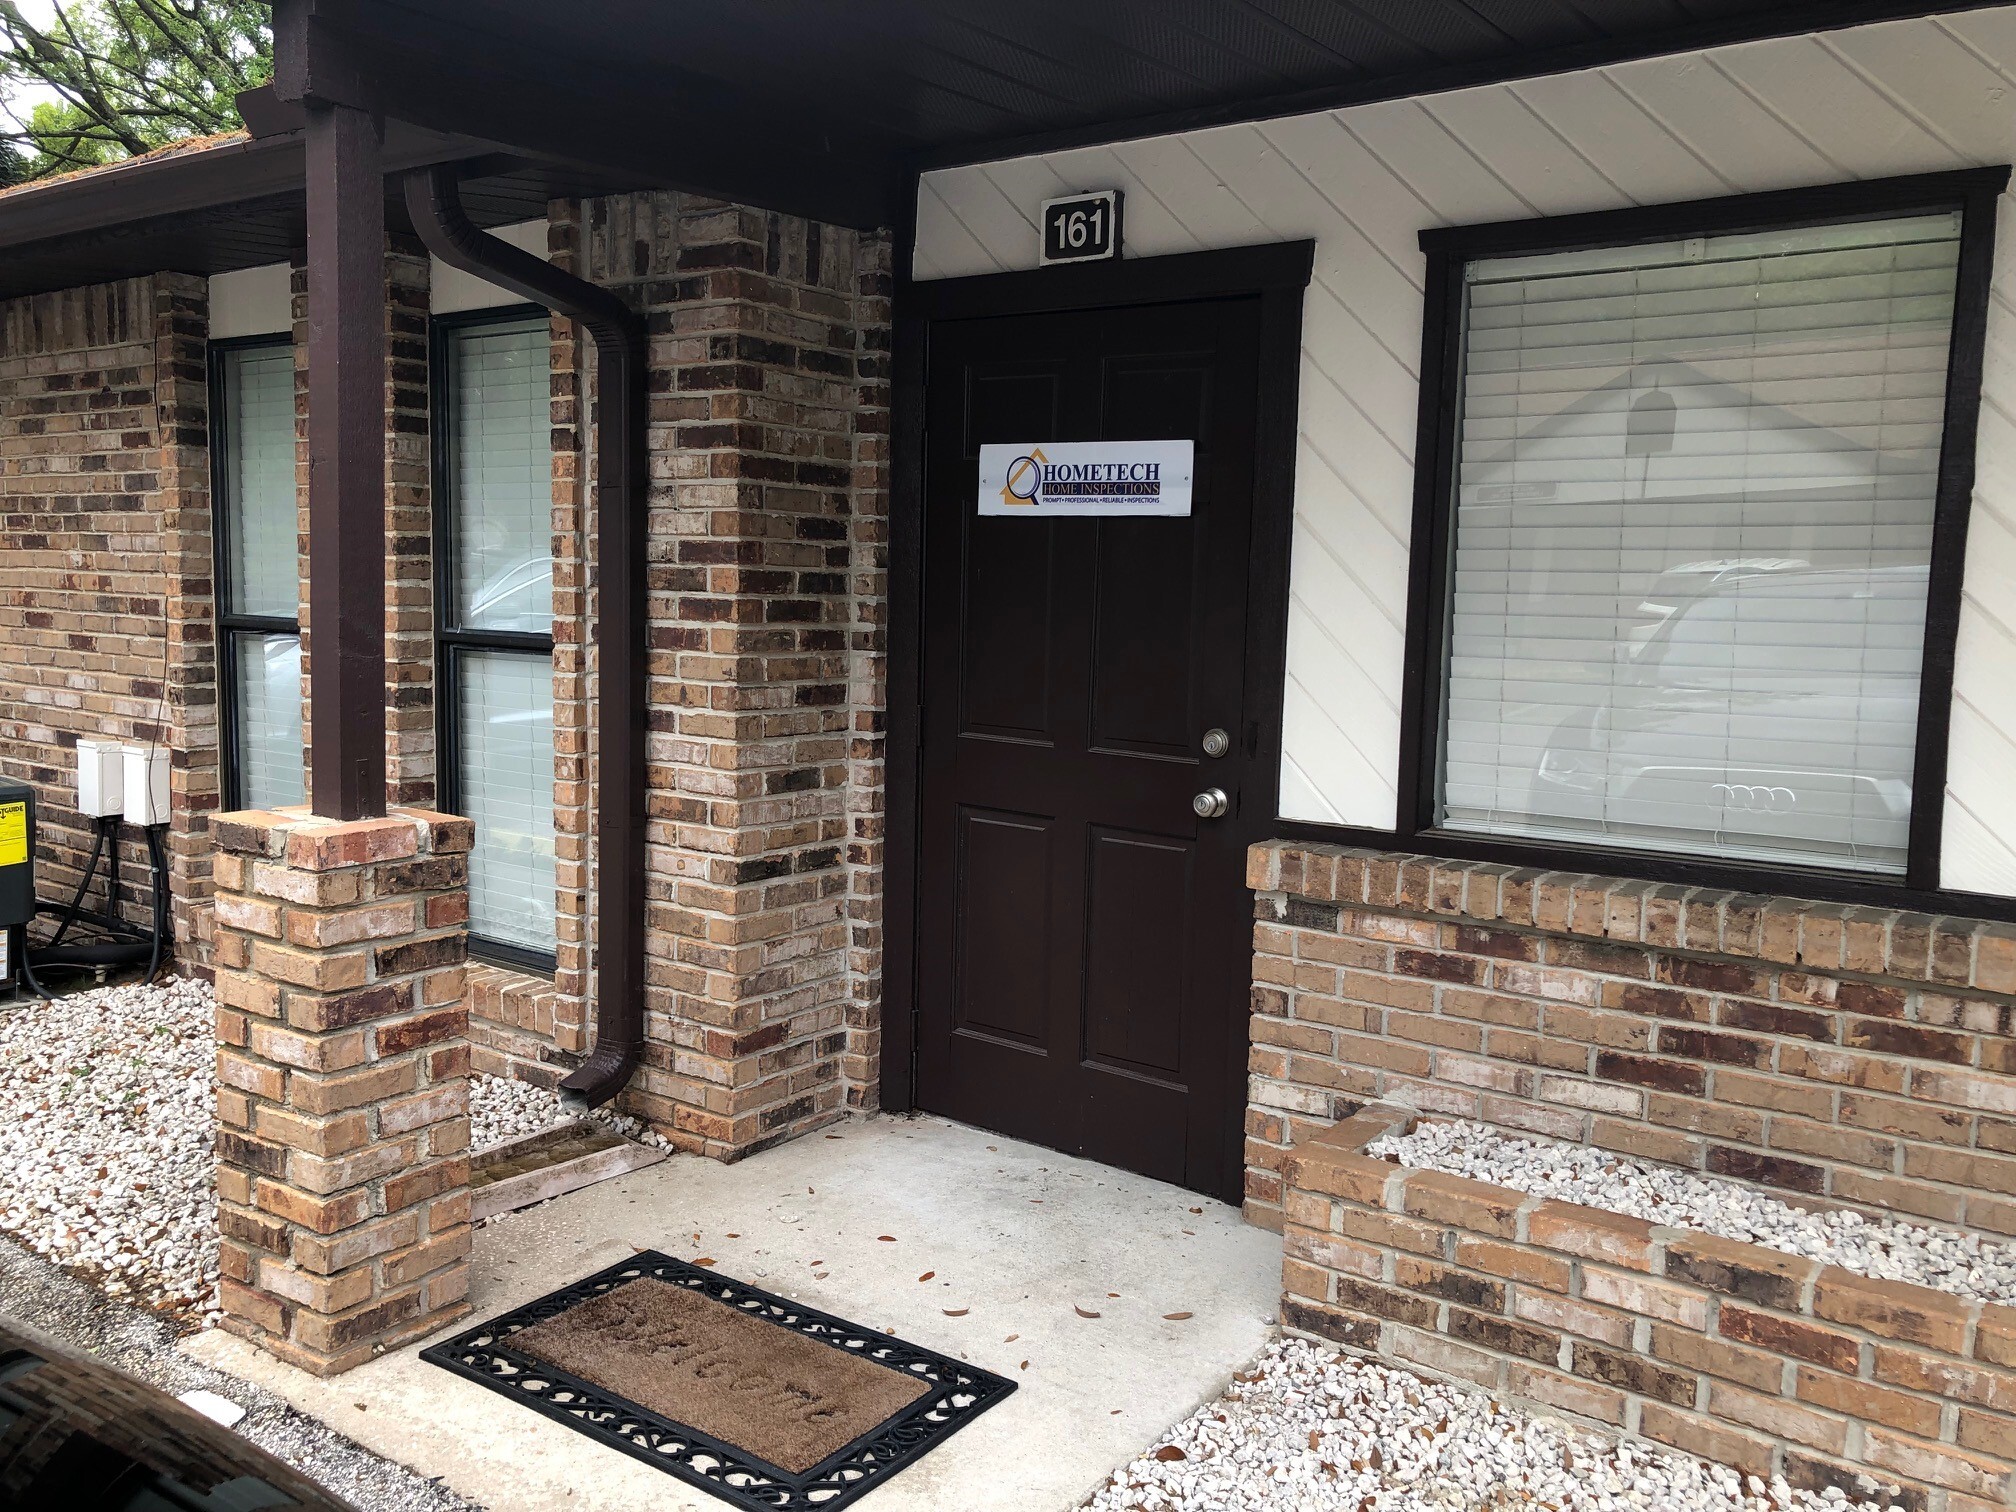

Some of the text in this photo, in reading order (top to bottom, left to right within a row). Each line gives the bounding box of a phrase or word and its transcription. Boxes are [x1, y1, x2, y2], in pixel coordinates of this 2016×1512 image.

[1053, 208, 1102, 250] 161
[1043, 463, 1161, 482] HOMETECH
[1043, 482, 1160, 495] HOME INSPECTIONS
